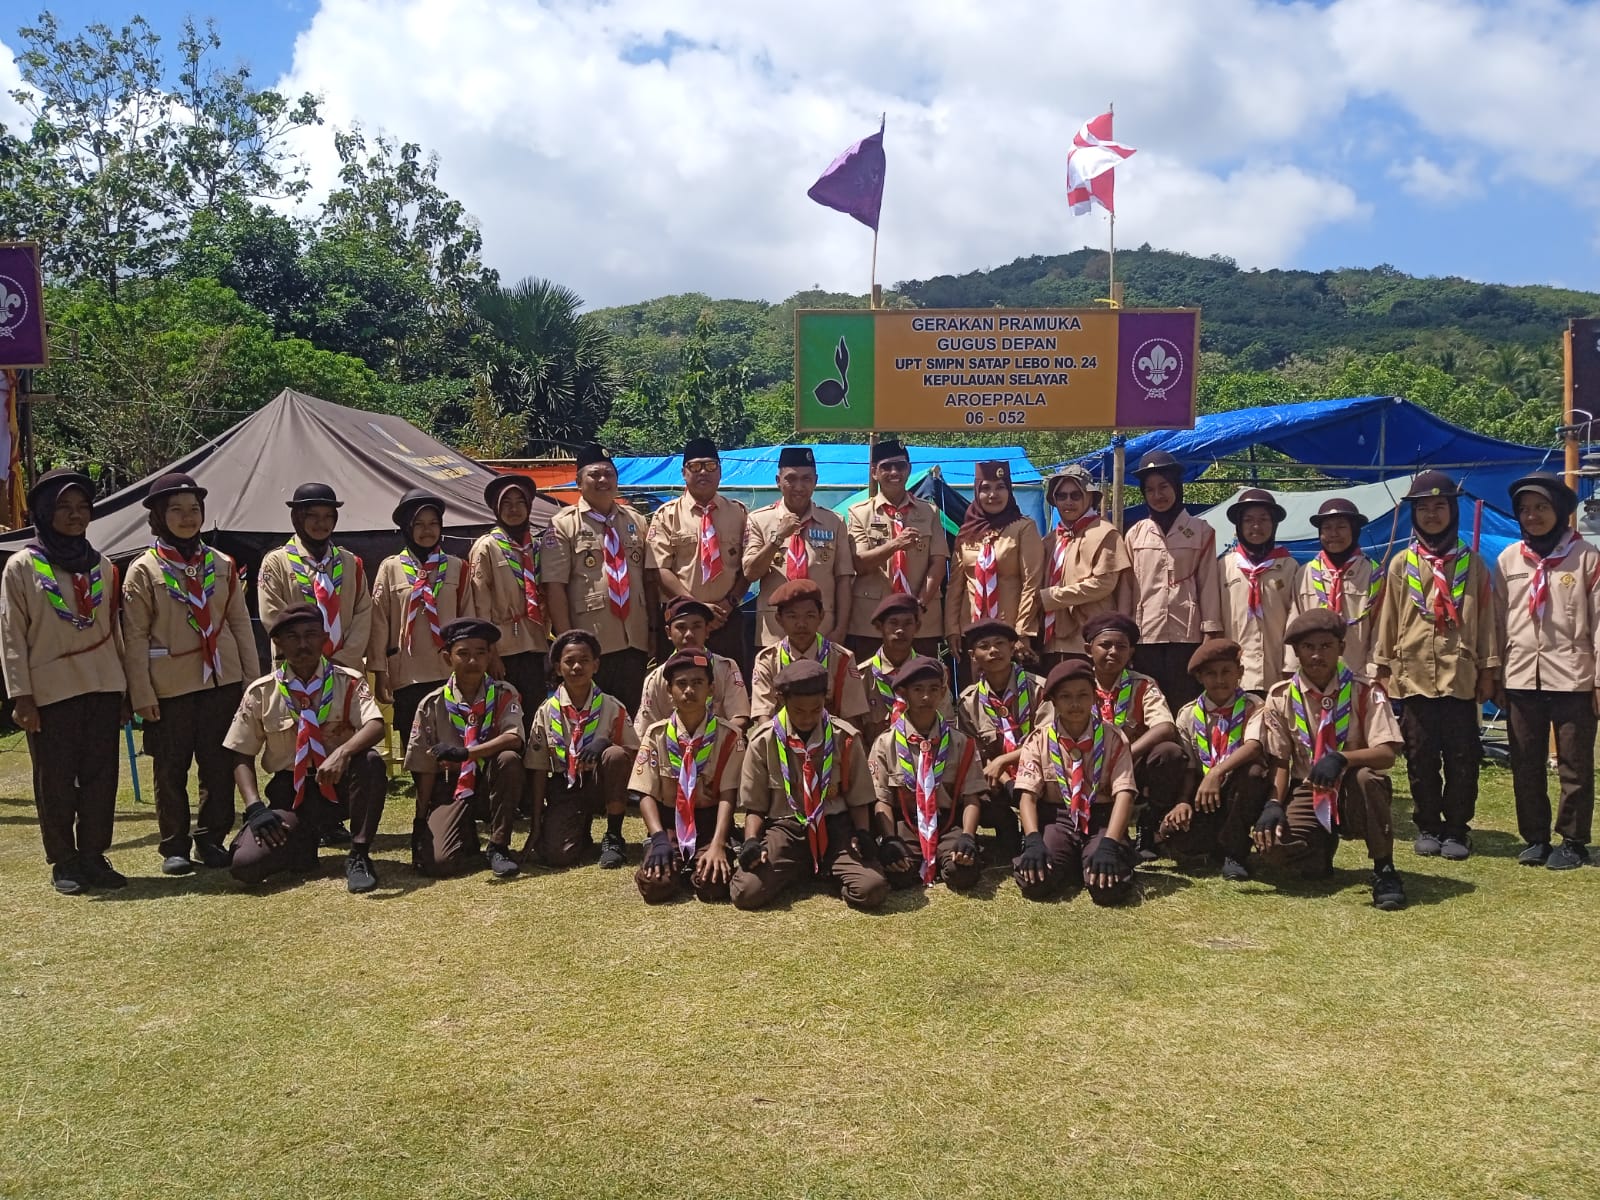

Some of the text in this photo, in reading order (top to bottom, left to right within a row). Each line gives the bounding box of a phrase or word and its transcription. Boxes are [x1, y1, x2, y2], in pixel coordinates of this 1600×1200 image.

[912, 317, 1081, 331] GERAKAN PRAMUKA
[938, 338, 1057, 351] GUGUS DEPAN
[895, 356, 1097, 370] UPT SMPN SATAP LEBO NO. 24
[923, 373, 1068, 386] KEPULAUAN SELAYAR
[945, 393, 1046, 407] AROEPPALA
[965, 412, 984, 425] 06
[998, 411, 1025, 424] 052
